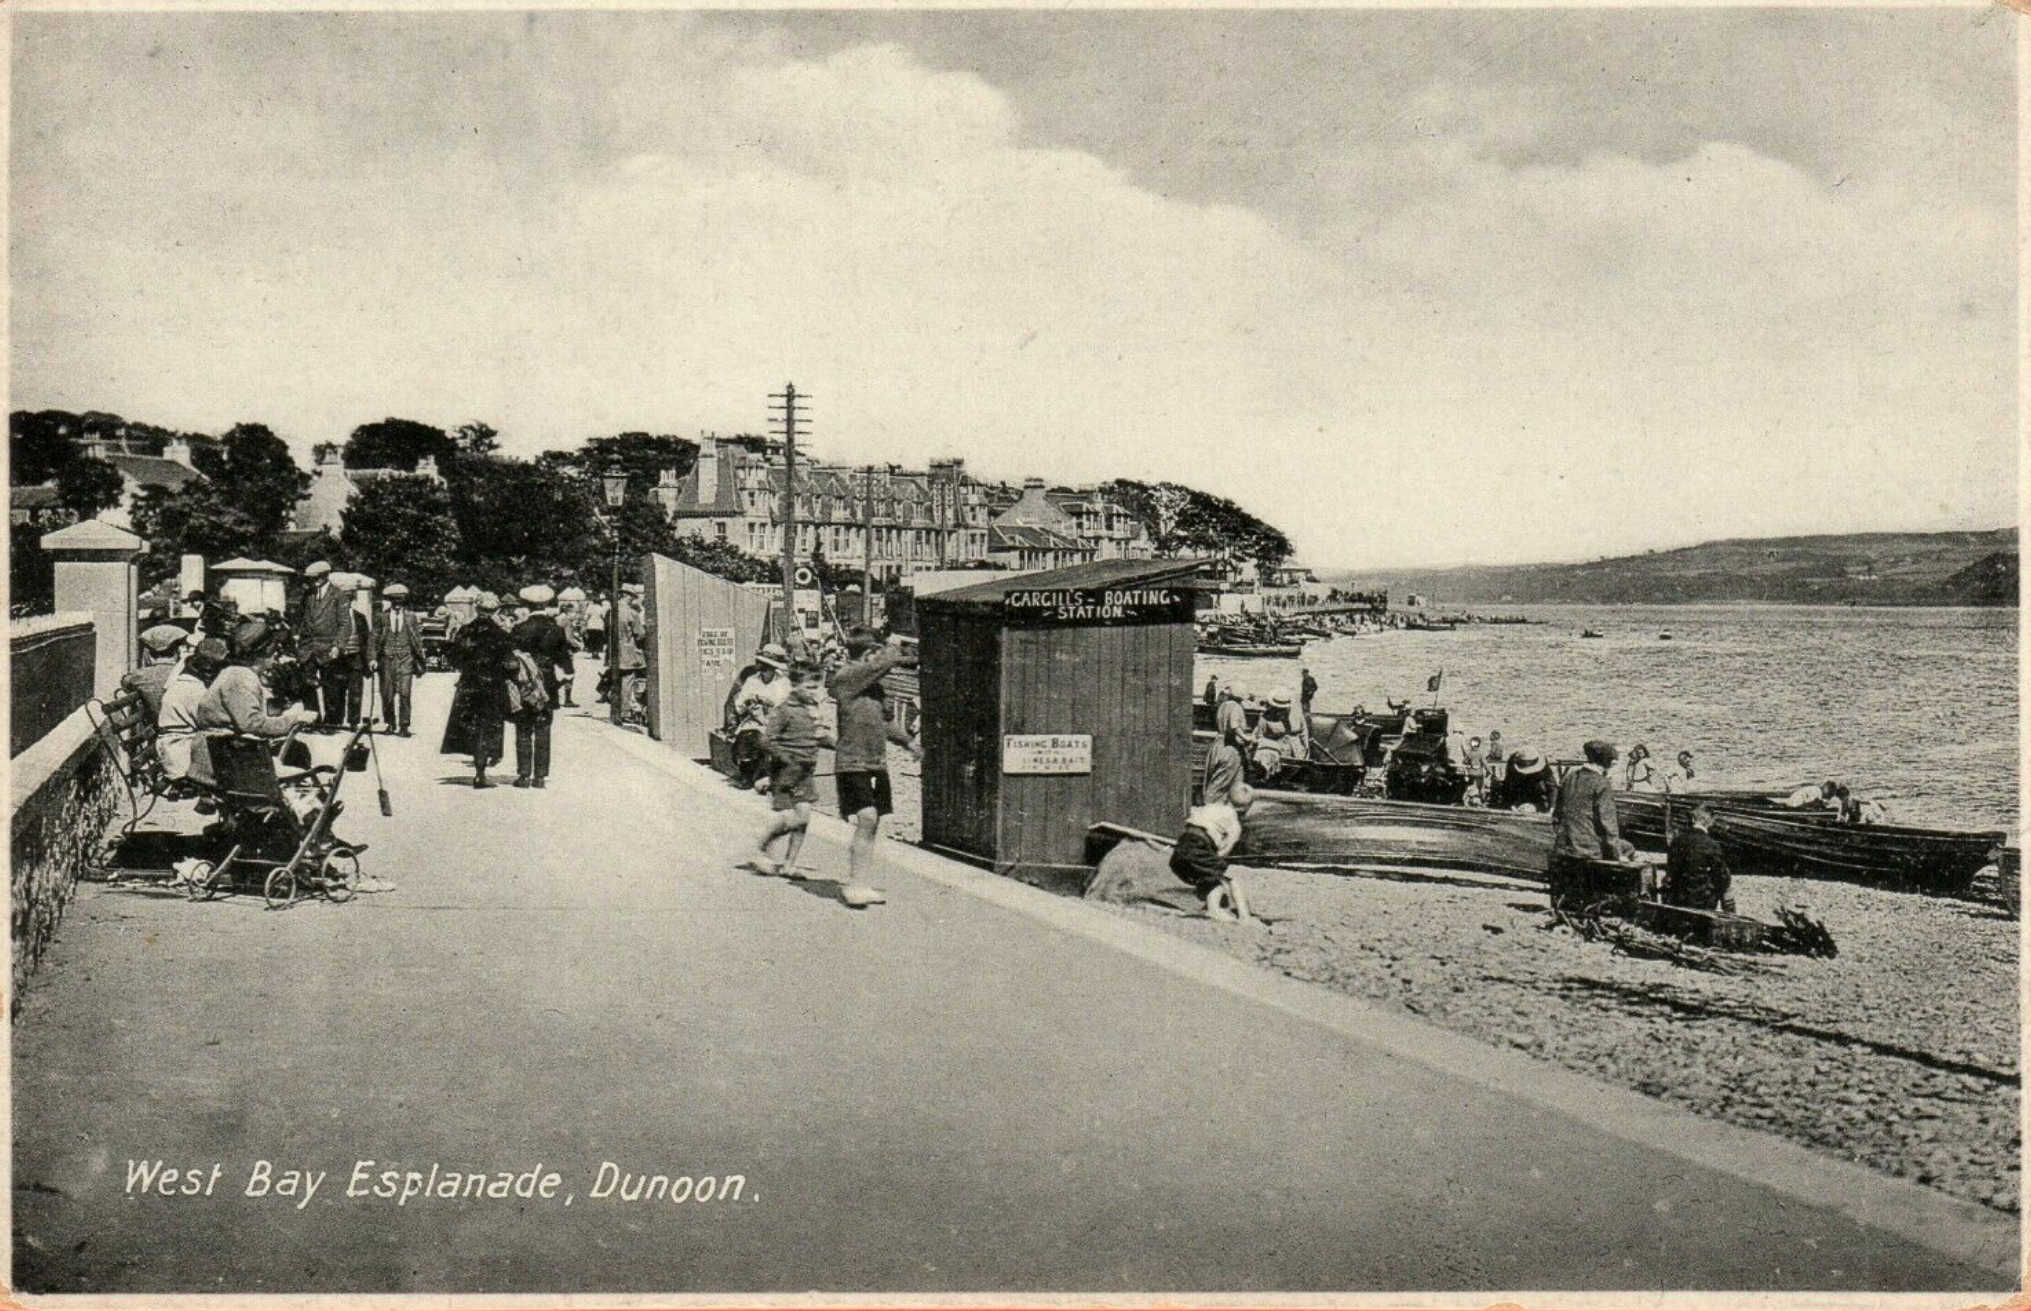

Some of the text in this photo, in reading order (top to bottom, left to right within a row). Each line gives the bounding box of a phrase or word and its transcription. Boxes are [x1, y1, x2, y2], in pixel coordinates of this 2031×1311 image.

[1105, 590, 1170, 605] BOATING
[1006, 738, 1088, 748] FISHING BOATS
